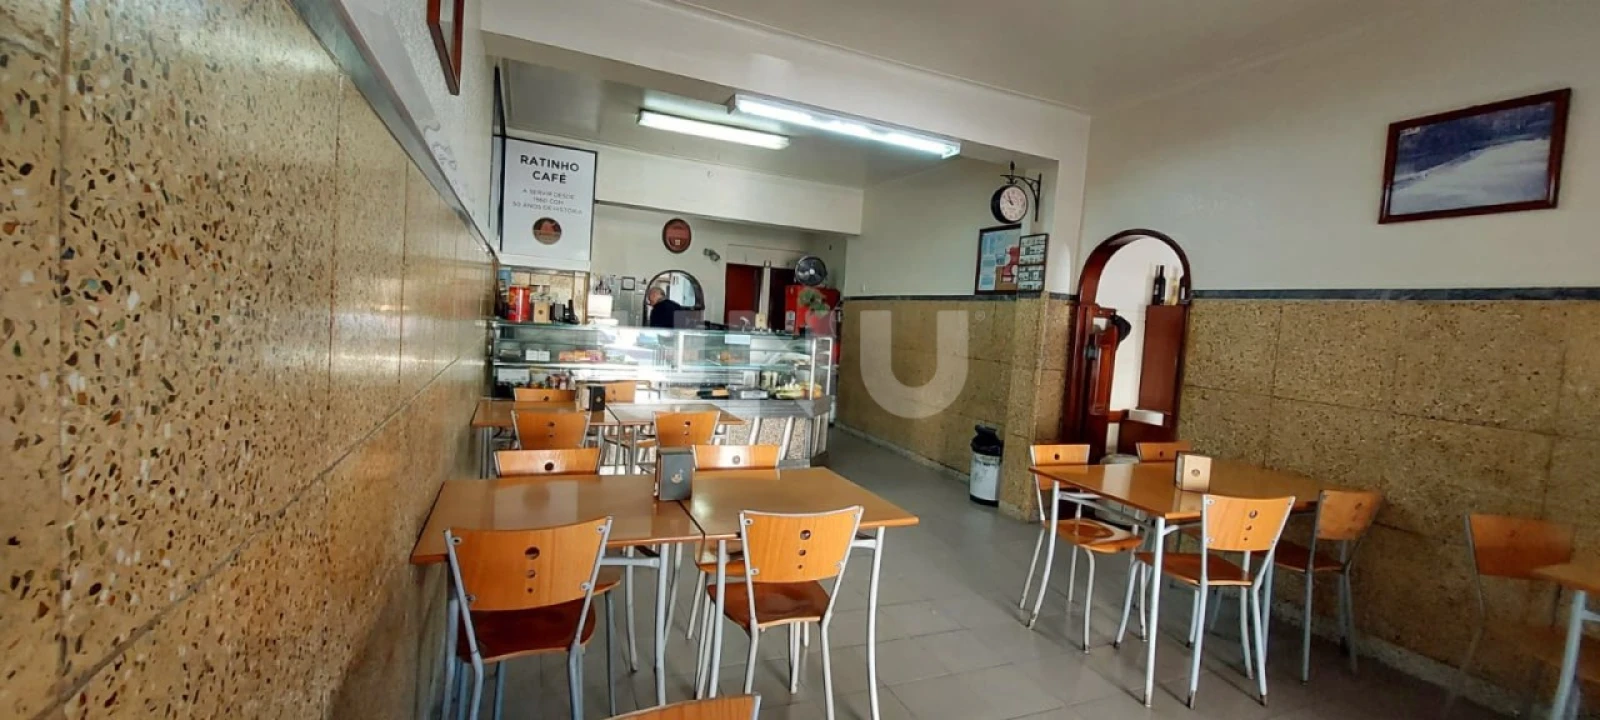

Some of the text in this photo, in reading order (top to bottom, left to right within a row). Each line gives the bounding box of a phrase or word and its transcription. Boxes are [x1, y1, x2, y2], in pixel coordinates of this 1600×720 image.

[520, 155, 580, 171] RATINHO
[532, 170, 567, 184] CAFÉ
[553, 192, 575, 200] DESDE
